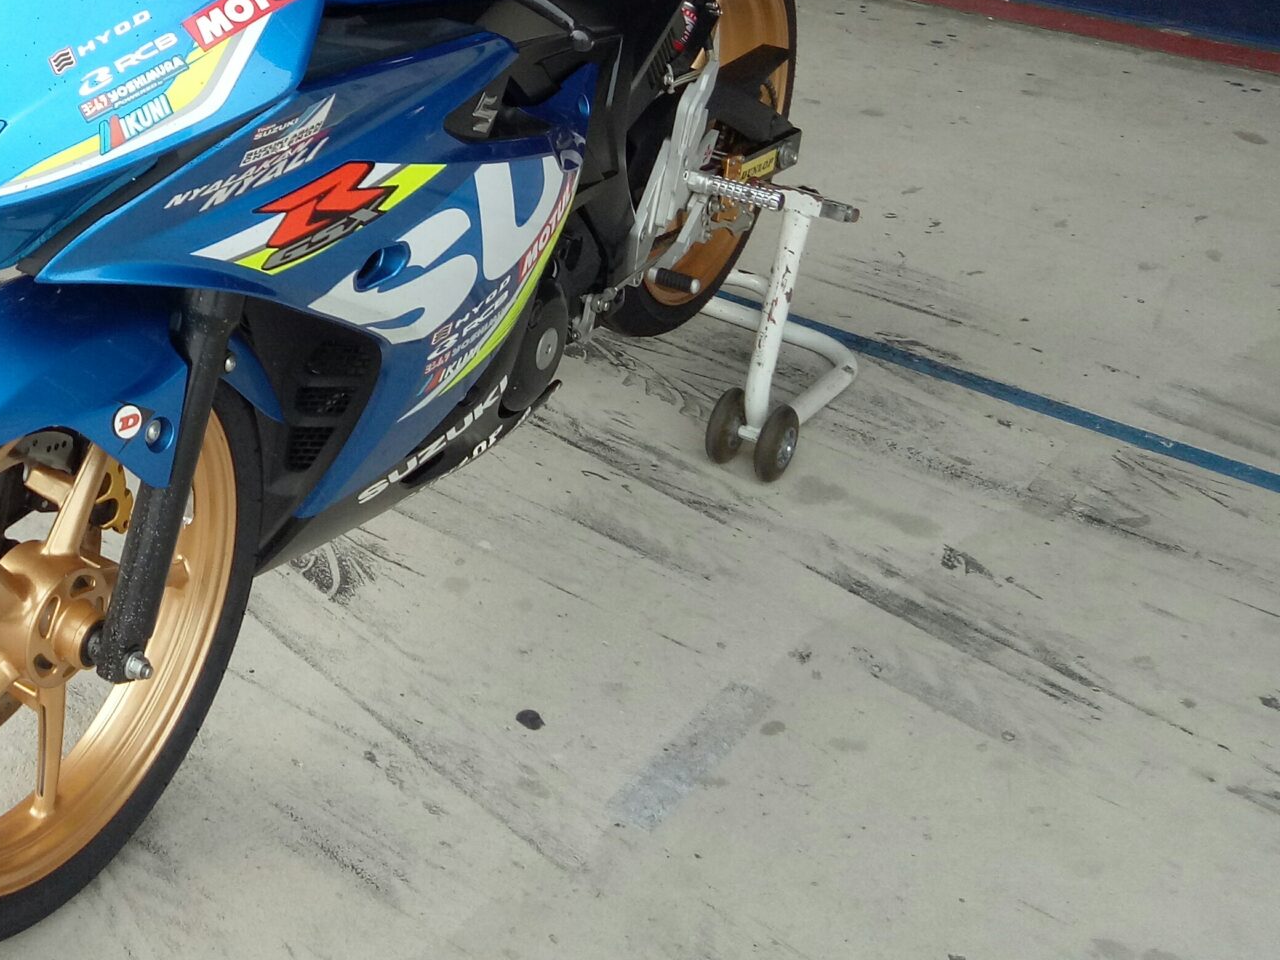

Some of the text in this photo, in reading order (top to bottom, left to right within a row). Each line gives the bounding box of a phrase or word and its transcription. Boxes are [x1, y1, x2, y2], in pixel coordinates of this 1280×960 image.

[77, 10, 151, 57] HYOD
[114, 32, 179, 75] RCB
[109, 55, 188, 103] YOSHIMURA
[253, 117, 300, 141] SUZUKI
[741, 155, 776, 181] DUNLOP
[455, 274, 511, 329] HYOD
[357, 374, 508, 505] SUZUKI
